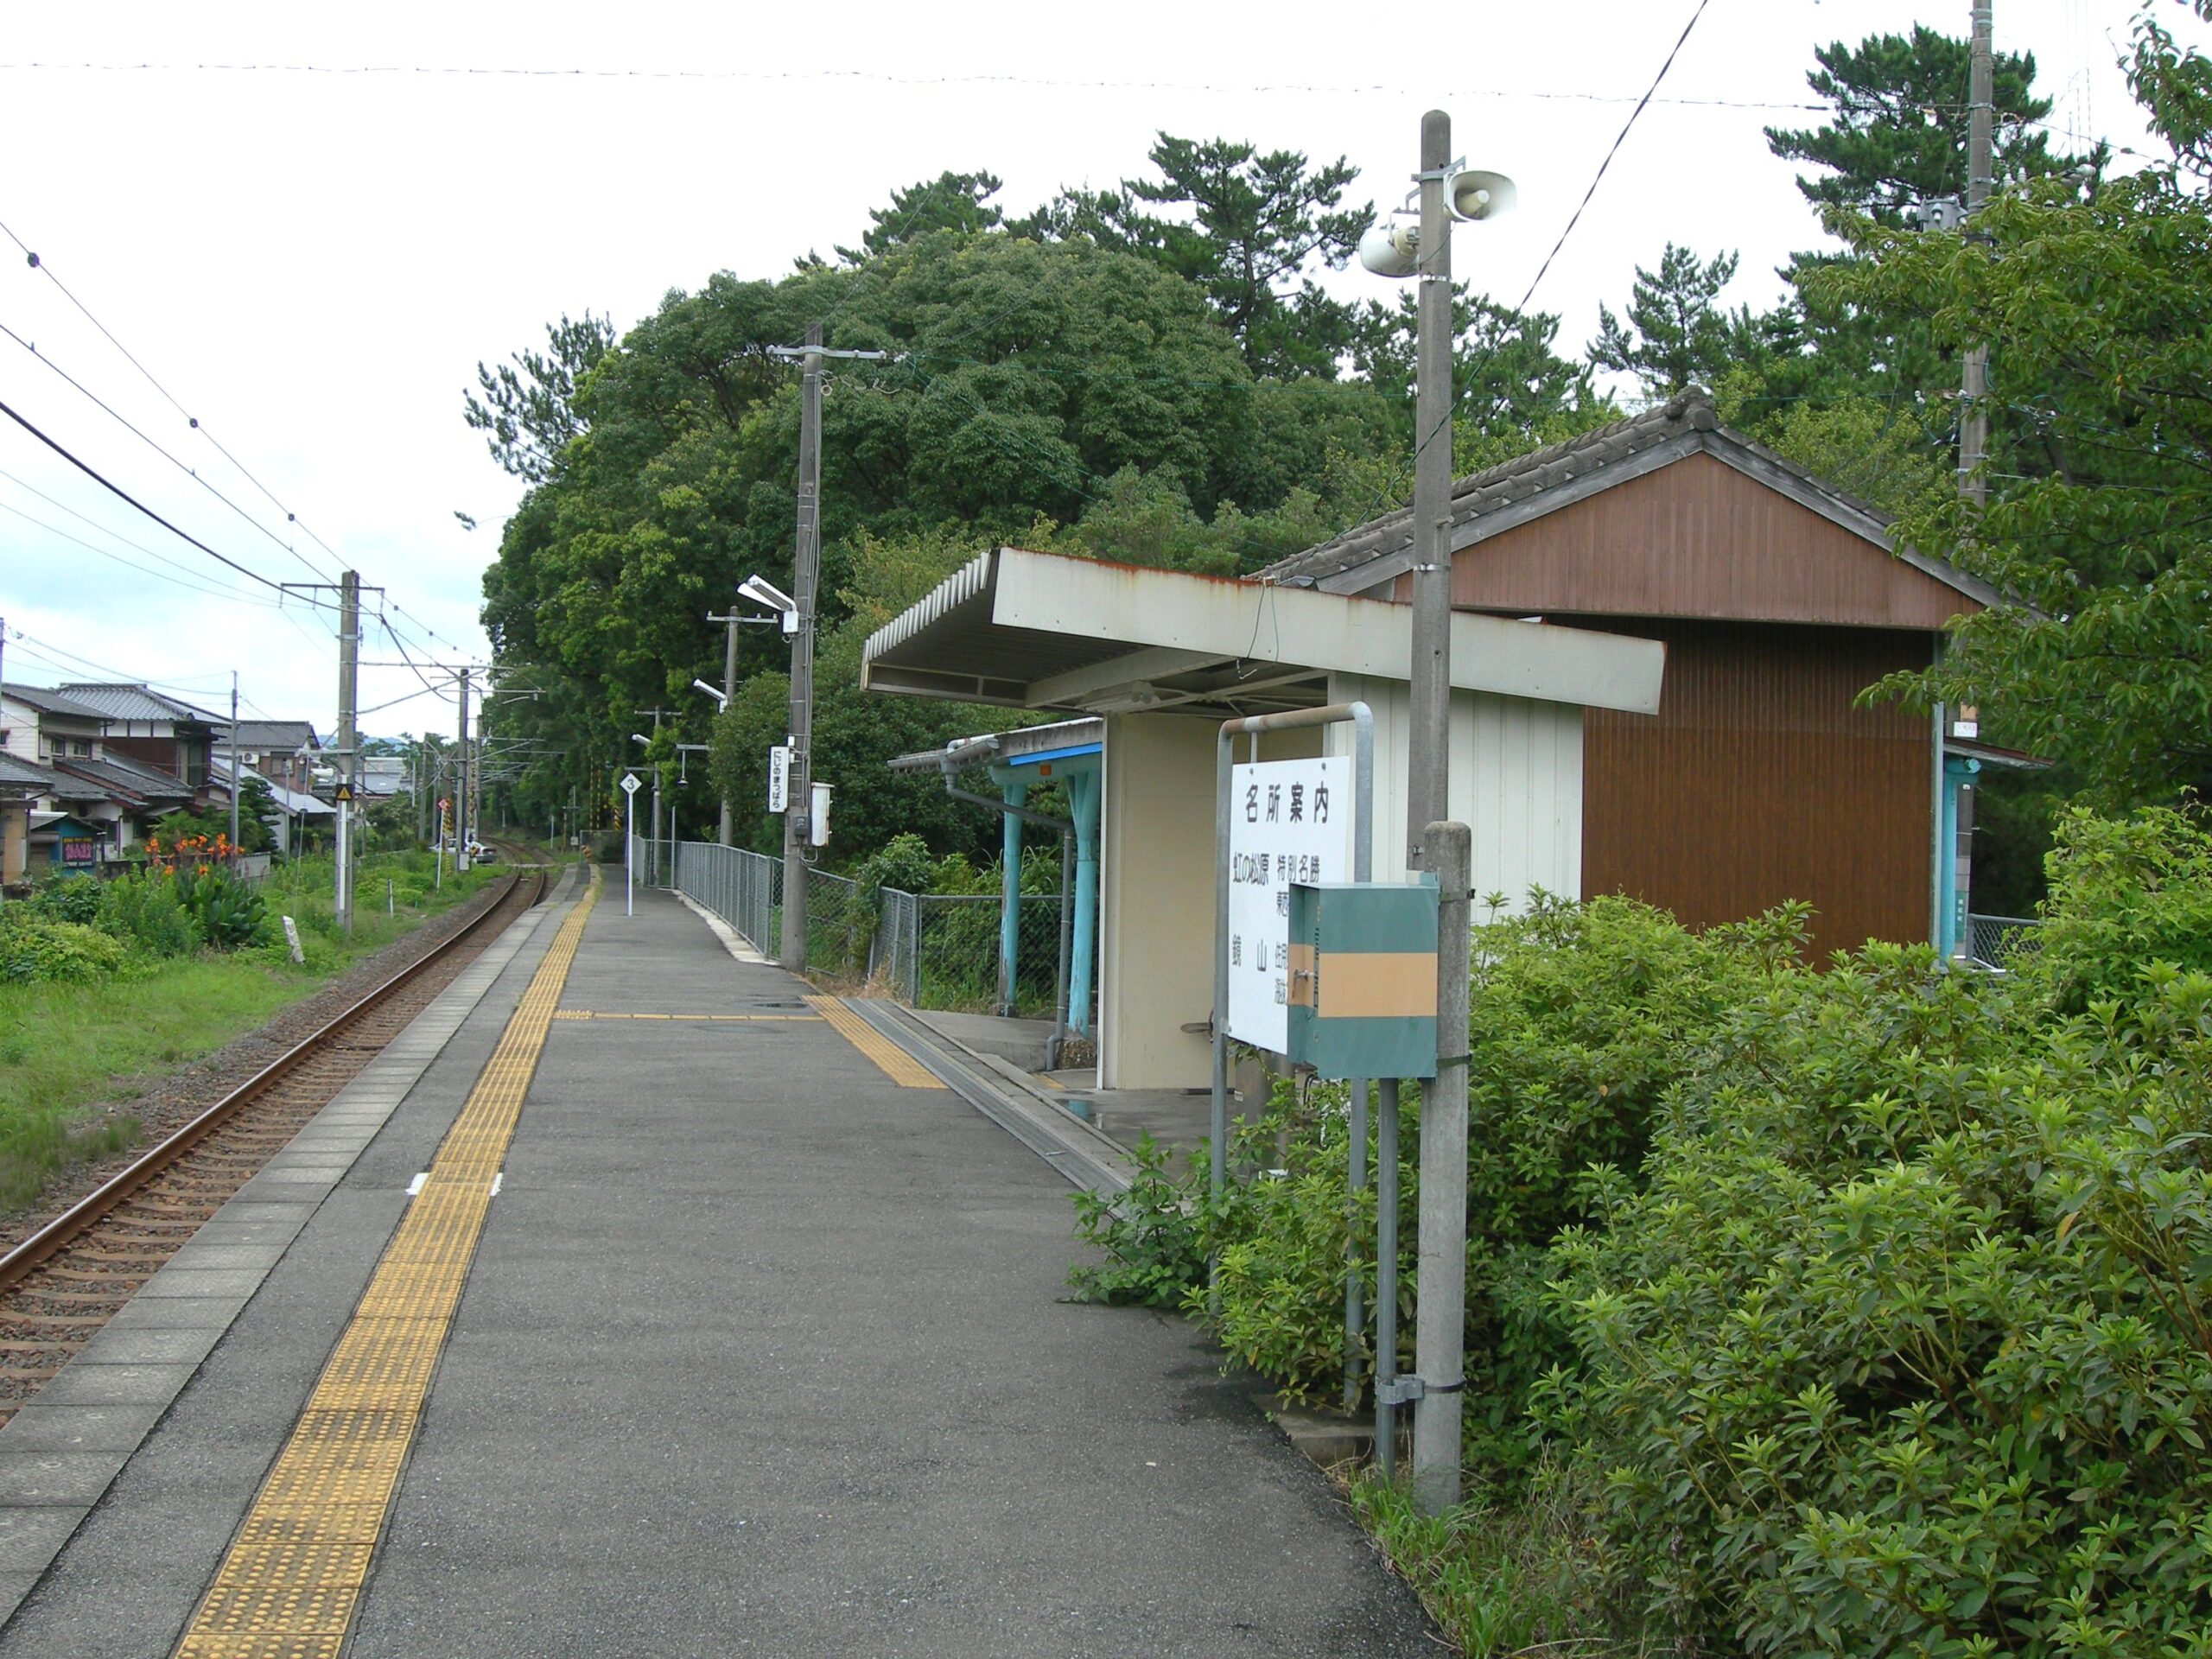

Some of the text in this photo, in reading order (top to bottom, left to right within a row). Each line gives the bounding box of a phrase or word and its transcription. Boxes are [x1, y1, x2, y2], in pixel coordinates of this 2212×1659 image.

[627, 778, 635, 790] 3
[772, 750, 781, 809] にじのまつばら
[1245, 779, 1329, 824] 名所案内
[1232, 852, 1320, 887] 虹の松原 特別名勝
